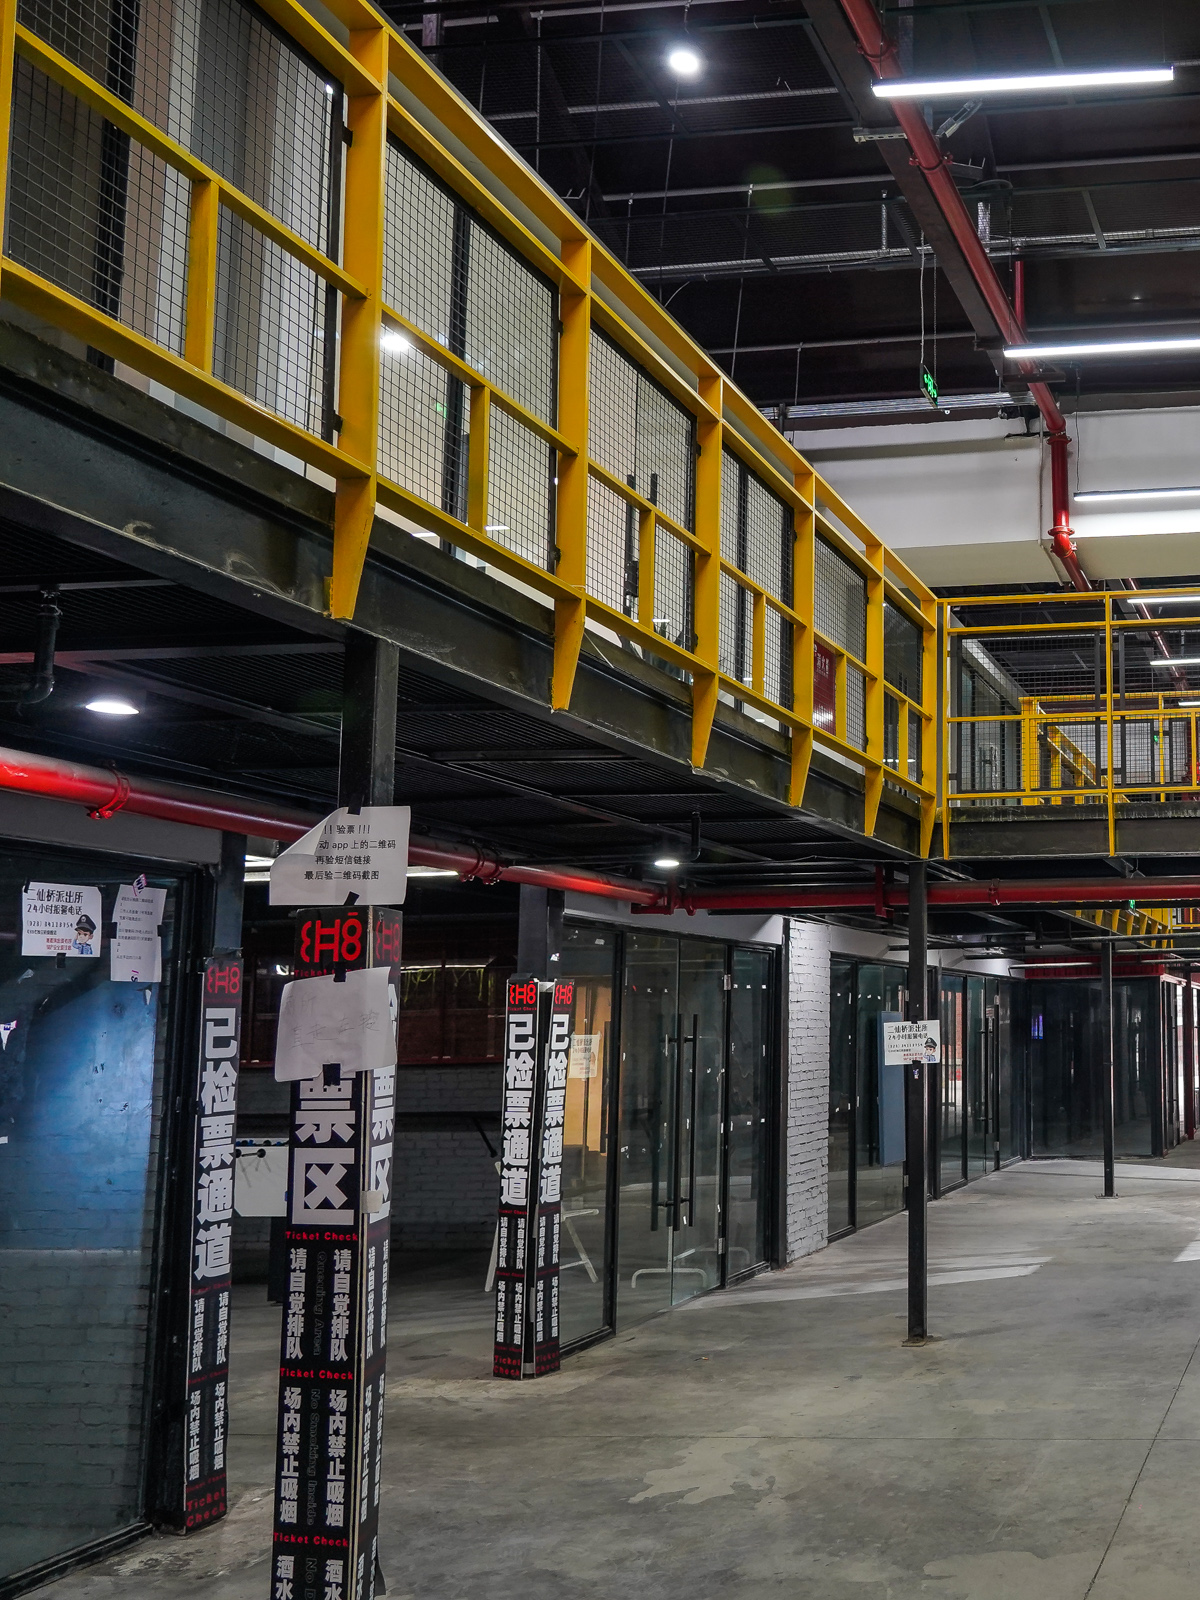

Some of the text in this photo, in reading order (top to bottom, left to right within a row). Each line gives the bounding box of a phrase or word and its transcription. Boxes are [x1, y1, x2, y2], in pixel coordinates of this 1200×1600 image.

[27, 888, 83, 903] 二仙桥派出所
[304, 871, 380, 881] 最后验二维码截图
[315, 855, 371, 865] 再验短信链接
[195, 1007, 238, 1280] 已检票通道
[500, 1013, 535, 1206] 已检票通道
[540, 1013, 570, 1205] 已检票通道
[285, 1231, 319, 1240] Ticket
[324, 1232, 358, 1241] Check
[192, 1298, 204, 1373] 请自觉排队
[216, 1291, 229, 1365] 请自觉排队
[286, 1248, 307, 1360] 请自觉排队
[330, 1249, 352, 1361] 请自觉排队
[279, 1368, 353, 1380] Ticket Check
[189, 1390, 201, 1481] 场内禁止吸烟
[214, 1382, 226, 1471] 场内禁止吸烟
[279, 1387, 301, 1524] 场内禁止吸烟
[325, 1389, 348, 1527] 场内禁止吸烟
[186, 1487, 225, 1512] Ticket
[186, 1505, 225, 1528] Check
[273, 1532, 348, 1547] Ticket Check
[275, 1555, 295, 1600] 酒水
